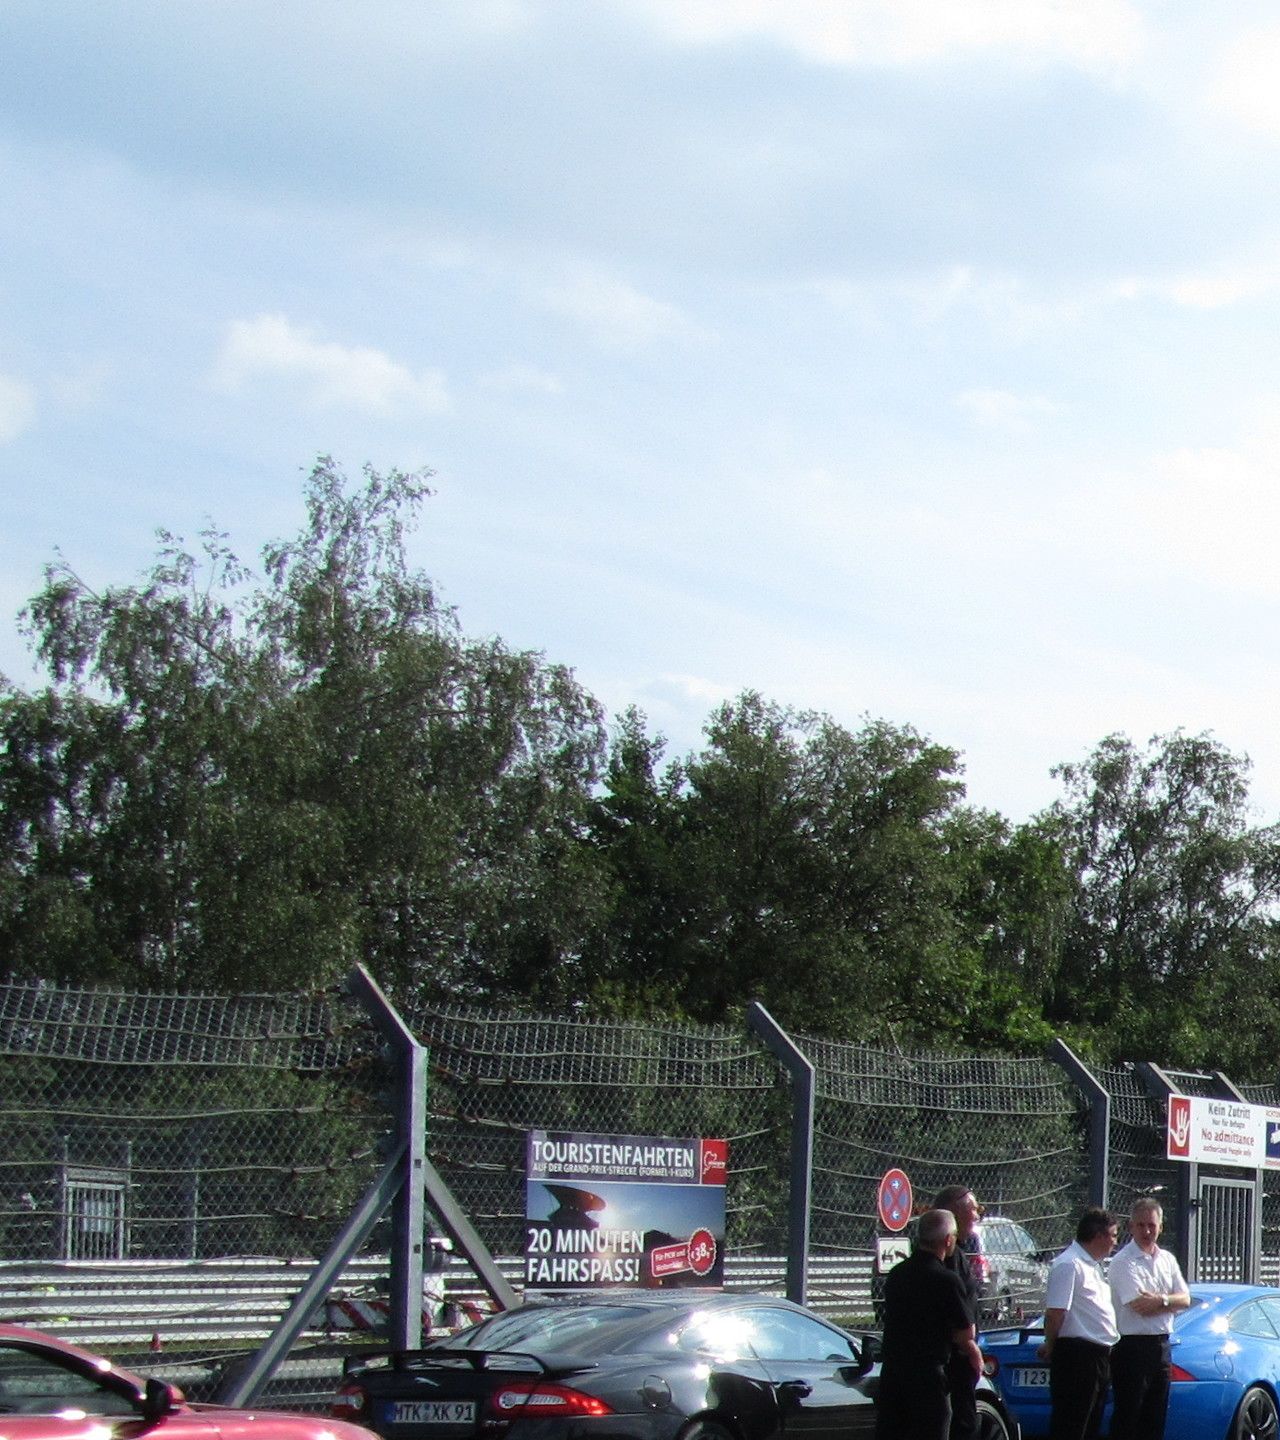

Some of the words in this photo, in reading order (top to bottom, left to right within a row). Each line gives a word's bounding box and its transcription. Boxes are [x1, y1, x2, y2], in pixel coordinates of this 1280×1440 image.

[1208, 1102, 1226, 1116] Kein
[1228, 1104, 1251, 1120] Zutritt
[1201, 1128, 1213, 1141] No
[1214, 1130, 1254, 1147] admittance
[532, 1140, 694, 1168] TOURISTENFAHRTEN
[533, 1162, 547, 1172] AUF
[548, 1162, 562, 1173] DER
[528, 1228, 552, 1253] 20
[555, 1229, 645, 1253] MINUTEN
[527, 1258, 639, 1283] FAHRSPASS!
[432, 1404, 450, 1421] XK
[455, 1404, 473, 1421] 91
